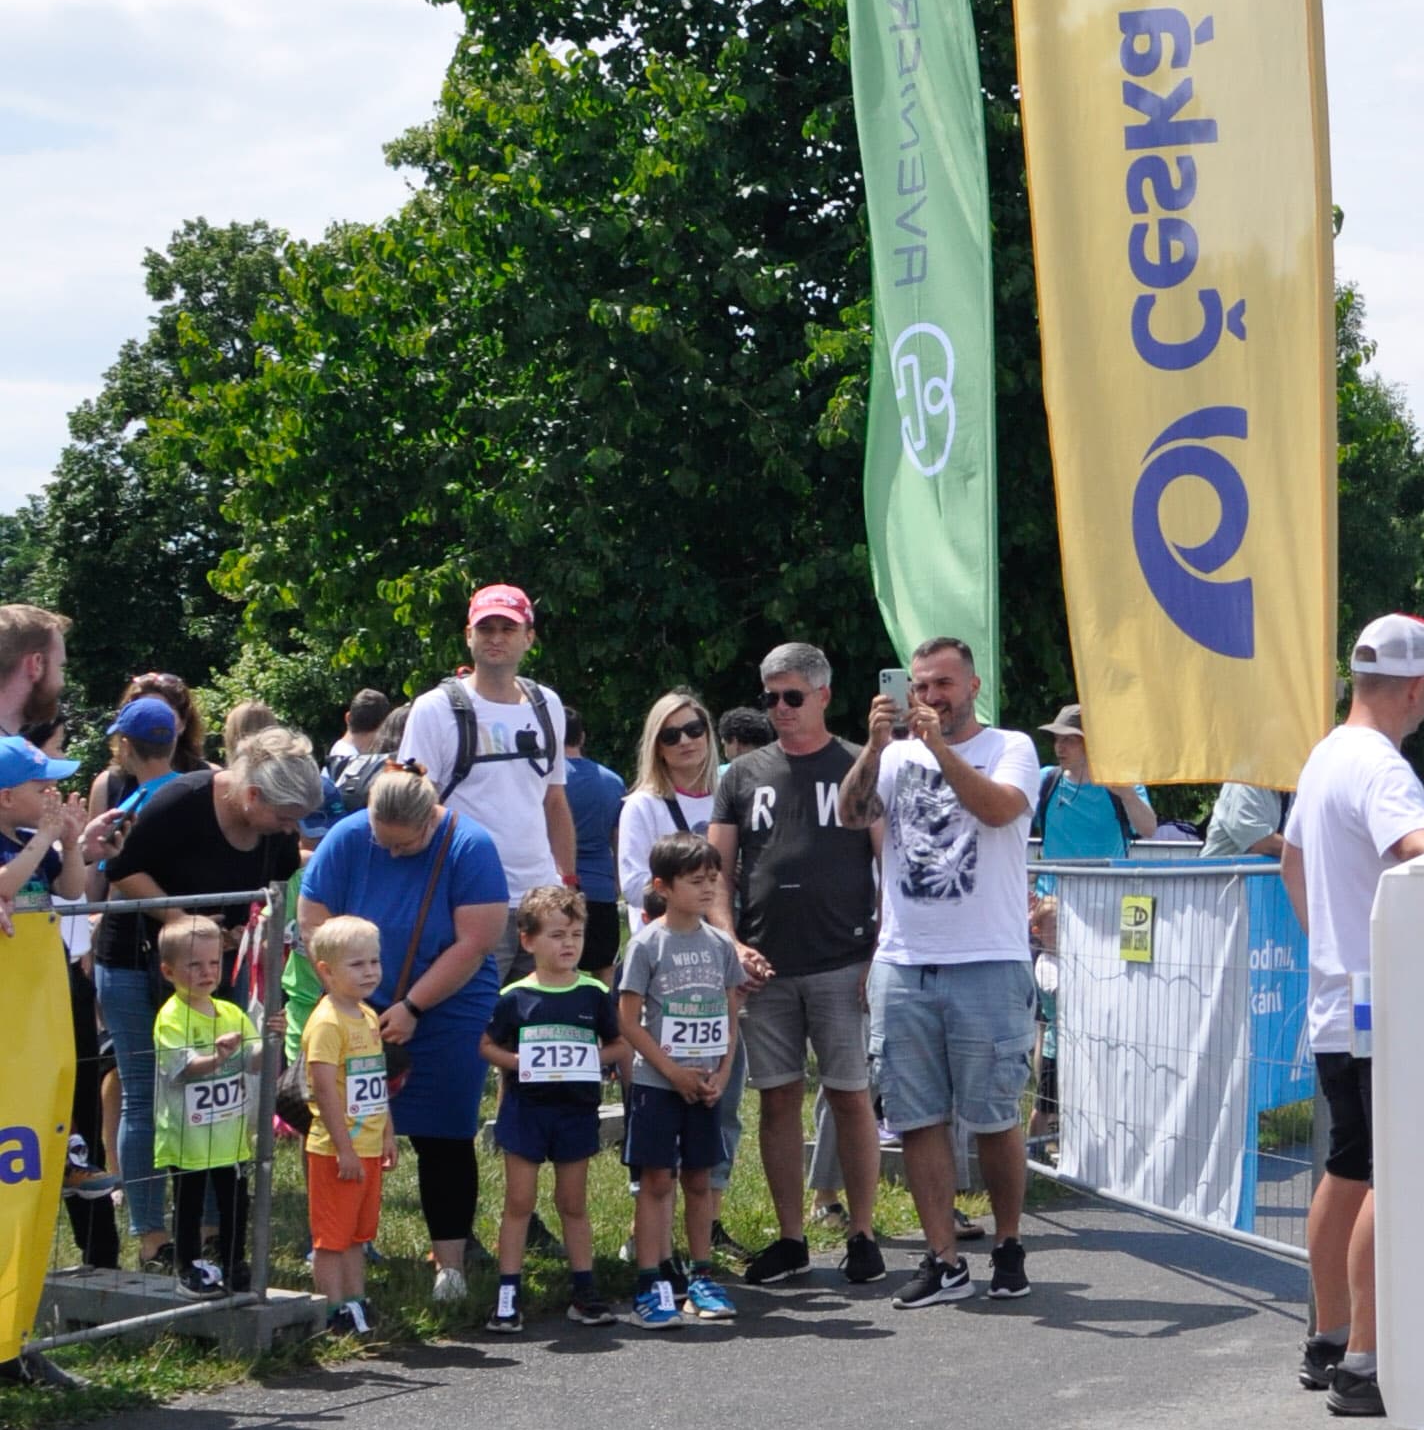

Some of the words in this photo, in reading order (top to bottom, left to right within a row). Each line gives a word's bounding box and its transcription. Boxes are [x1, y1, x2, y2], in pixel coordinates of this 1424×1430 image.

[1250, 939, 1295, 971] odinu,
[671, 1020, 723, 1044] 2136
[531, 1045, 589, 1068] 2137
